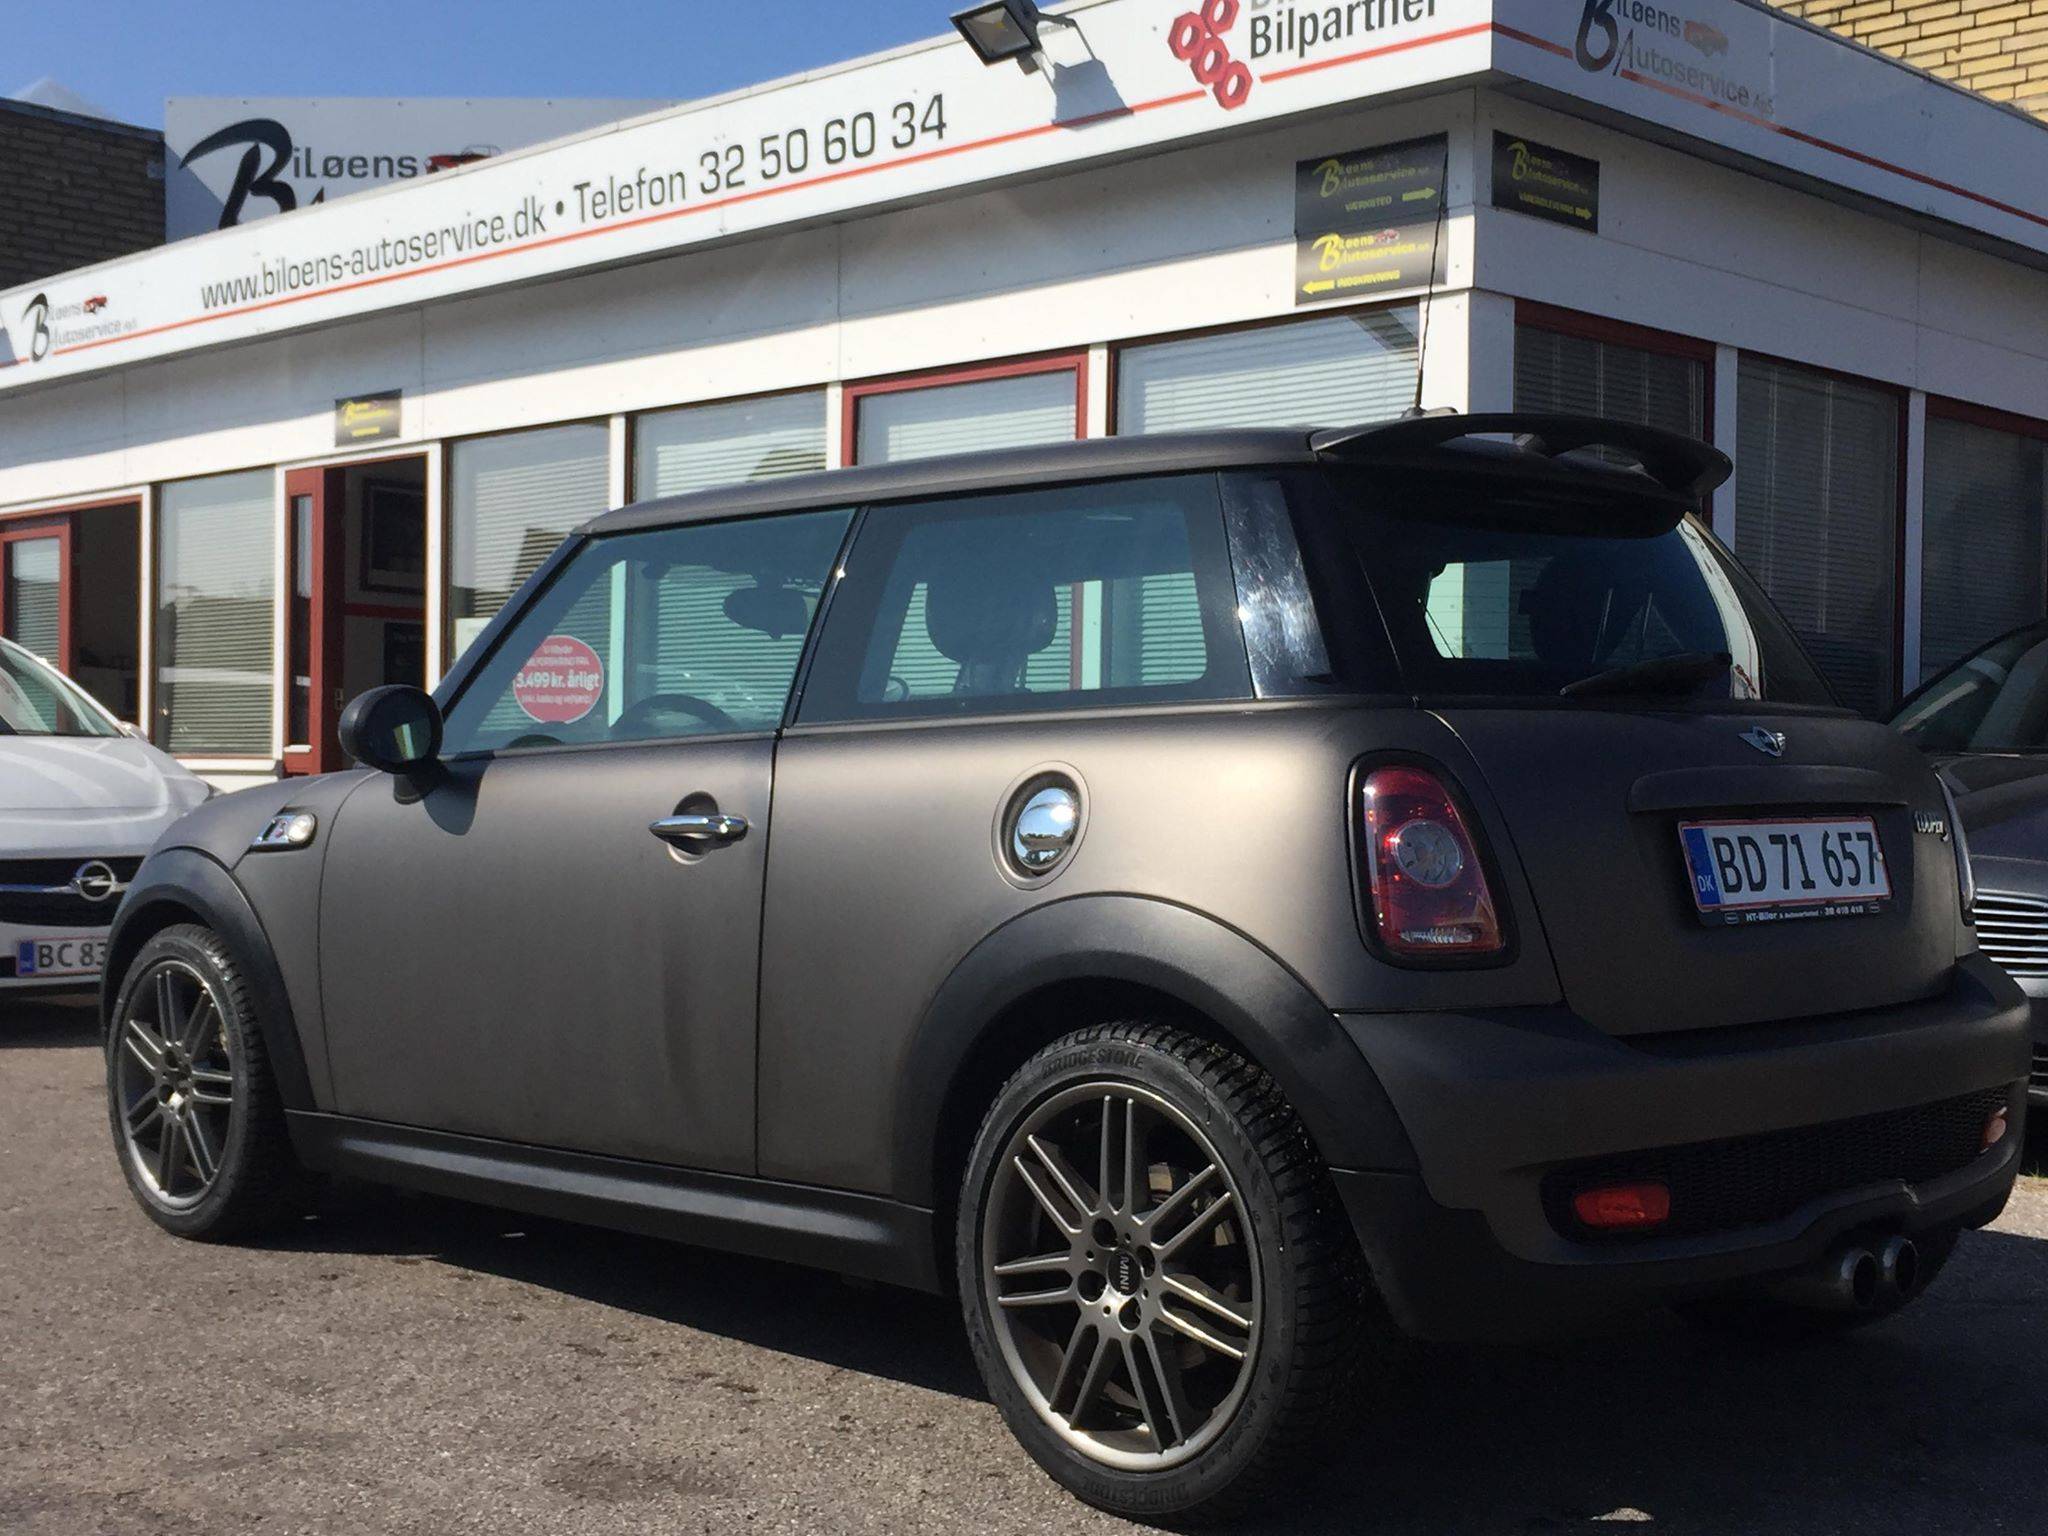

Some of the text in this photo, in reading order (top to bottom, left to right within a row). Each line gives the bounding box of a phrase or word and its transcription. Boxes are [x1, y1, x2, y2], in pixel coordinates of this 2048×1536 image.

[201, 93, 947, 309] www.biloens-autoservice.dk Telefon 32 50 60 34
[516, 668, 600, 691] 3.499 kr. årligt
[1712, 830, 1876, 894] BD 71 657
[1697, 874, 1715, 892] DK
[38, 942, 73, 968] BC
[1120, 1256, 1130, 1291] MINI
